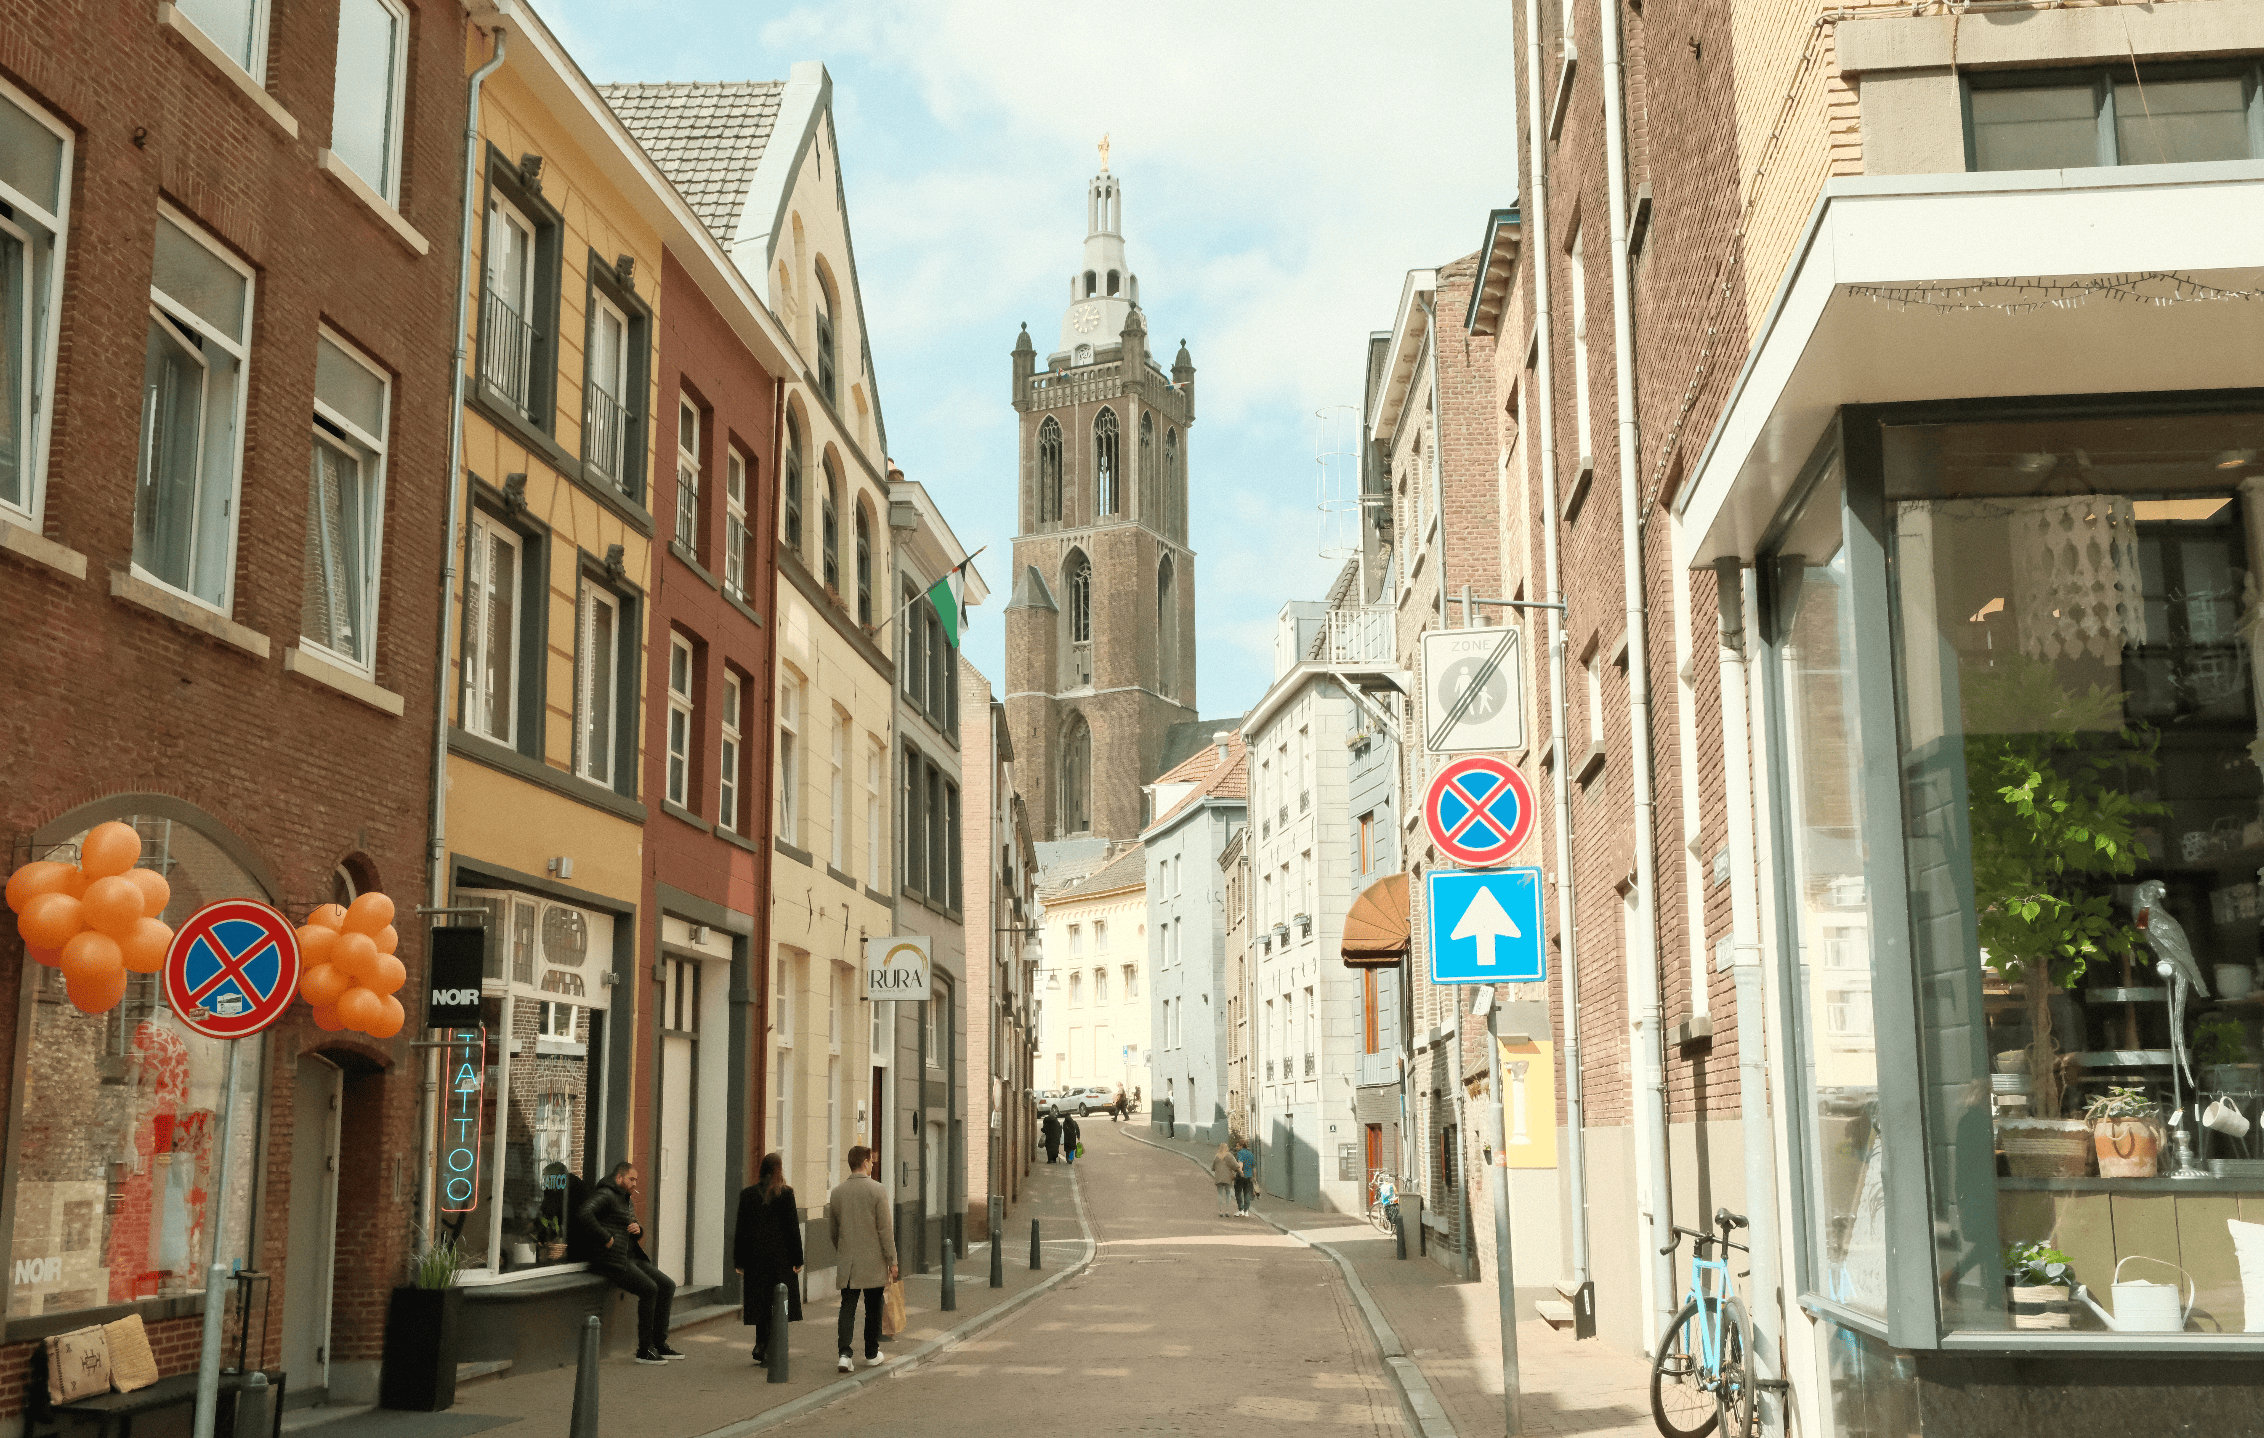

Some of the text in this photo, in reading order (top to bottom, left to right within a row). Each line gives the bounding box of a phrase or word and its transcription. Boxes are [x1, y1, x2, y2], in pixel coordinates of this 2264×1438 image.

[1451, 639, 1491, 652] ZONE
[870, 968, 923, 989] RURA
[432, 988, 480, 1006] NOIR
[446, 1034, 475, 1201] TATTOO
[14, 1257, 62, 1285] NOIR
